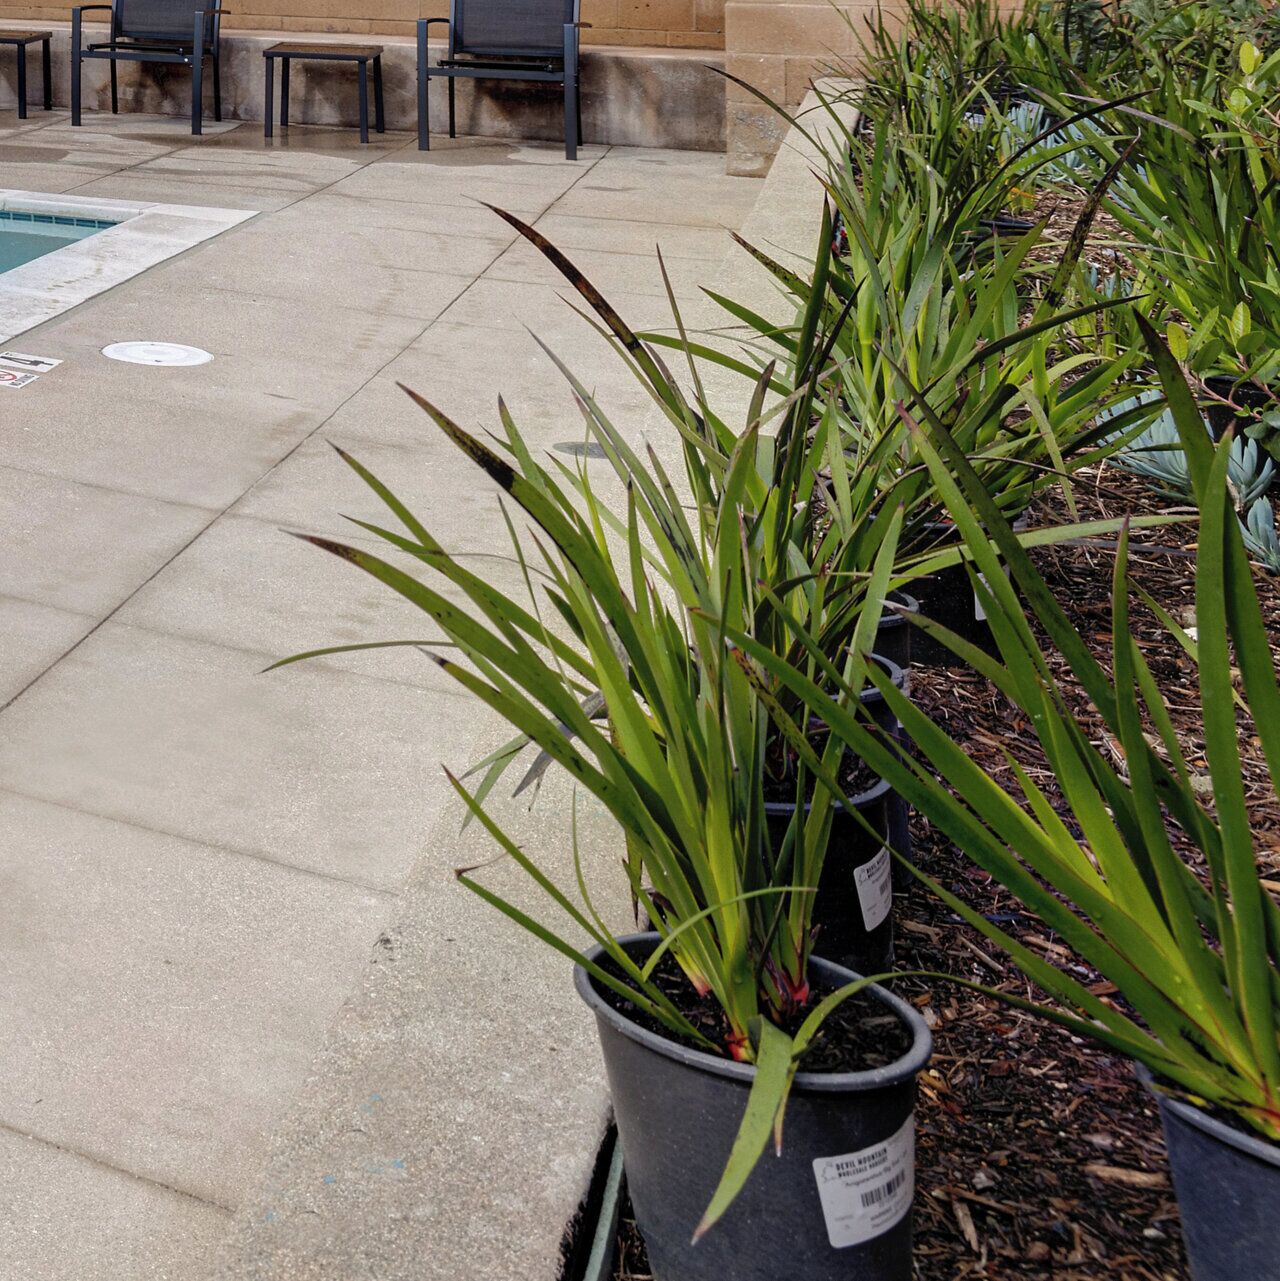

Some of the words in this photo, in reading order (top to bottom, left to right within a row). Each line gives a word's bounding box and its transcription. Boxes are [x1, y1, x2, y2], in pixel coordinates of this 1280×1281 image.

[836, 1161, 856, 1171] DEVIL
[858, 1148, 887, 1164] MOUNTAIN
[838, 1166, 867, 1178] WHOLESALE
